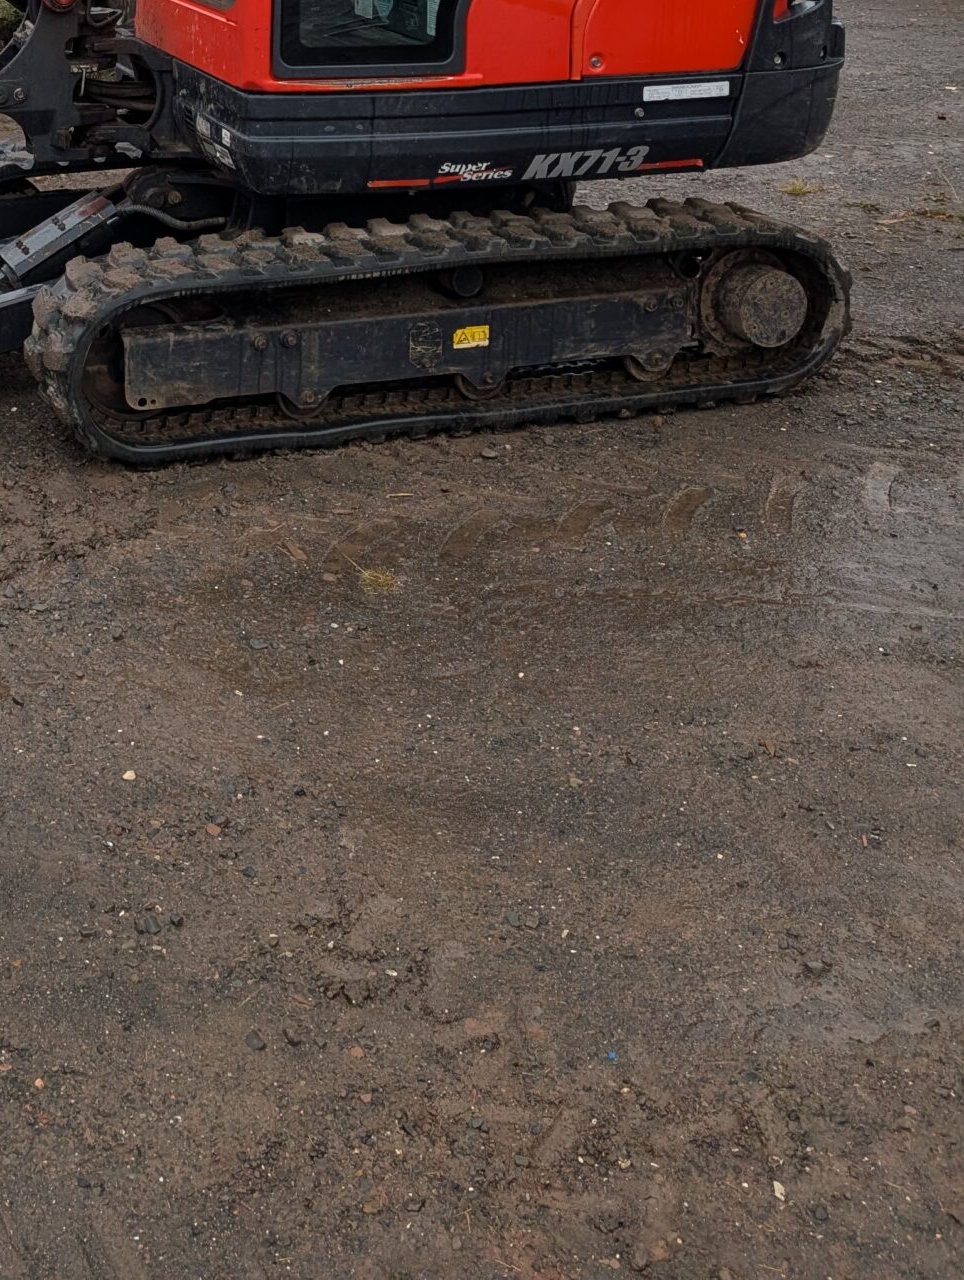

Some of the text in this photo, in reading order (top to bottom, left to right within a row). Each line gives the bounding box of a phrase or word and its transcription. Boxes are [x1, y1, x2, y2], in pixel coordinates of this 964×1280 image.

[438, 161, 490, 174] Super
[521, 145, 650, 181] KX71-3
[460, 168, 514, 182] Series
